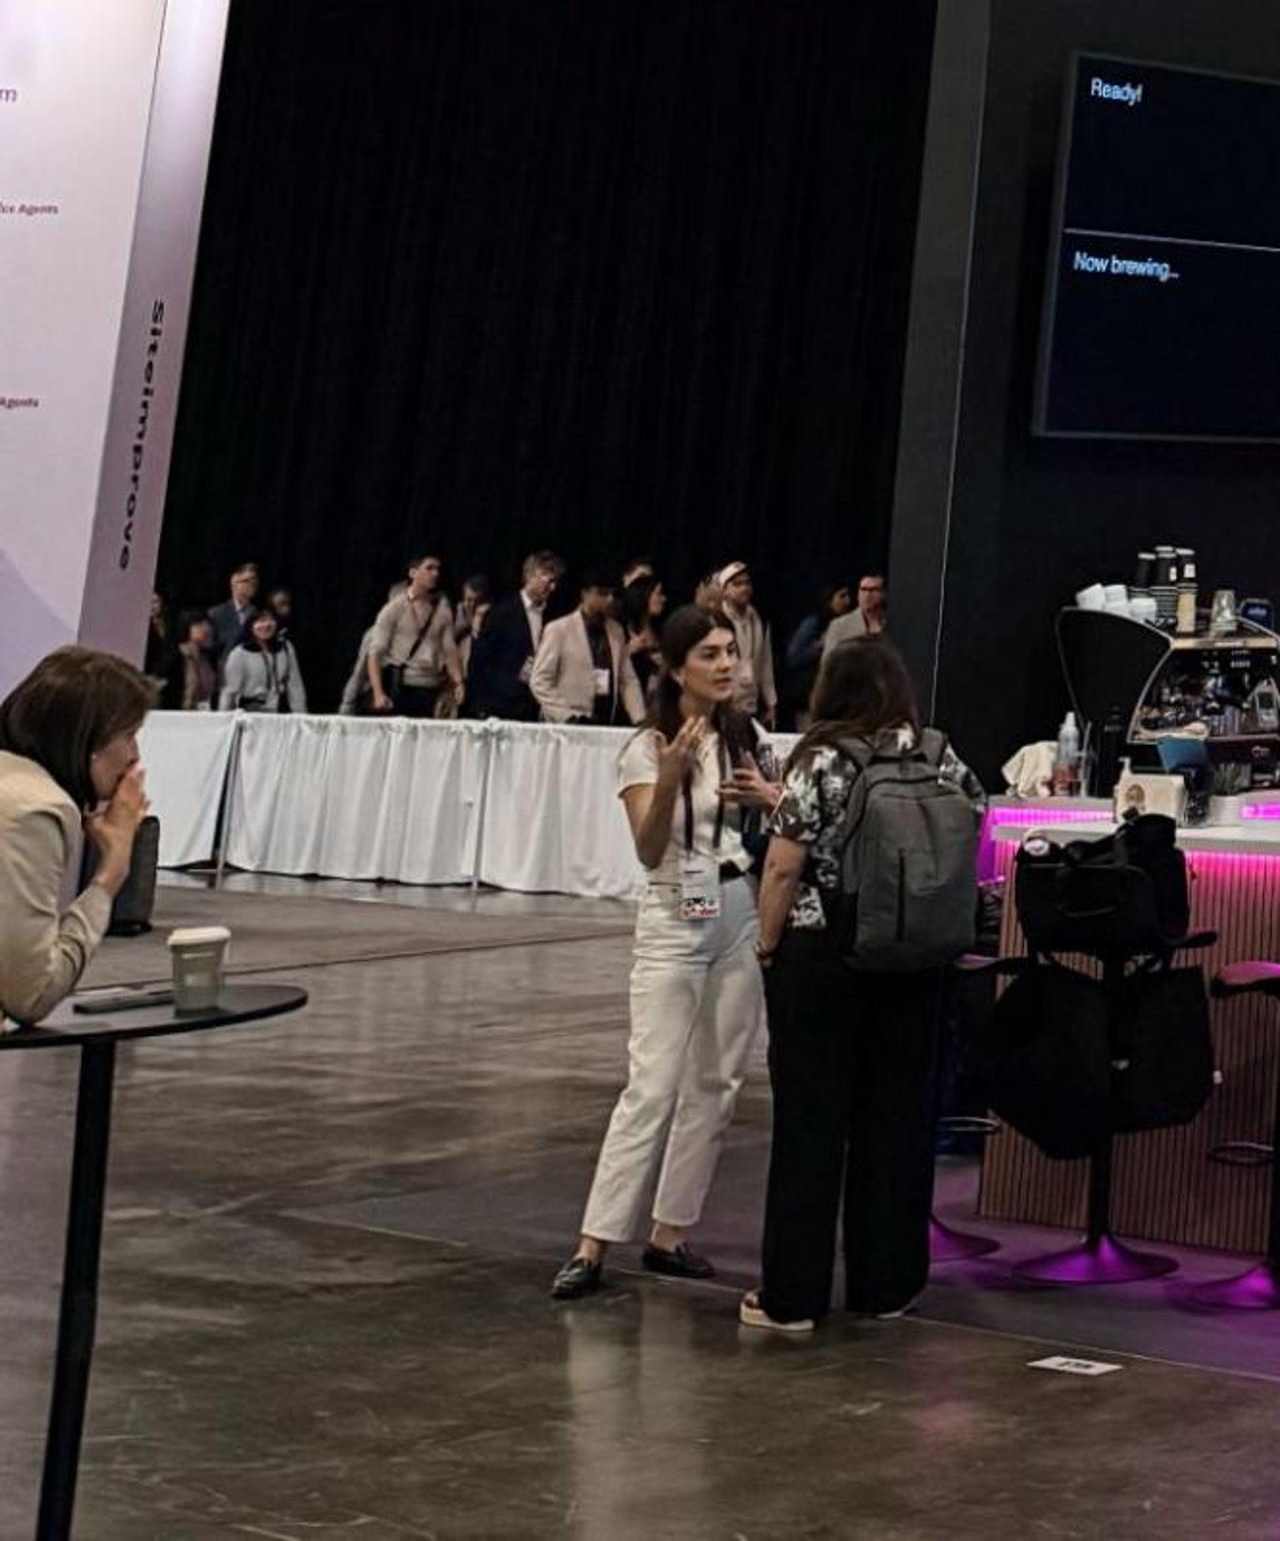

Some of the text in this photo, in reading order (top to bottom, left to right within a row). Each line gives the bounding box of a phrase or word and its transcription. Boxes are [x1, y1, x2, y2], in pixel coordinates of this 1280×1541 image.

[1090, 76, 1144, 106] Ready!
[1073, 251, 1109, 273] Now
[119, 299, 164, 571] Siteimprove
